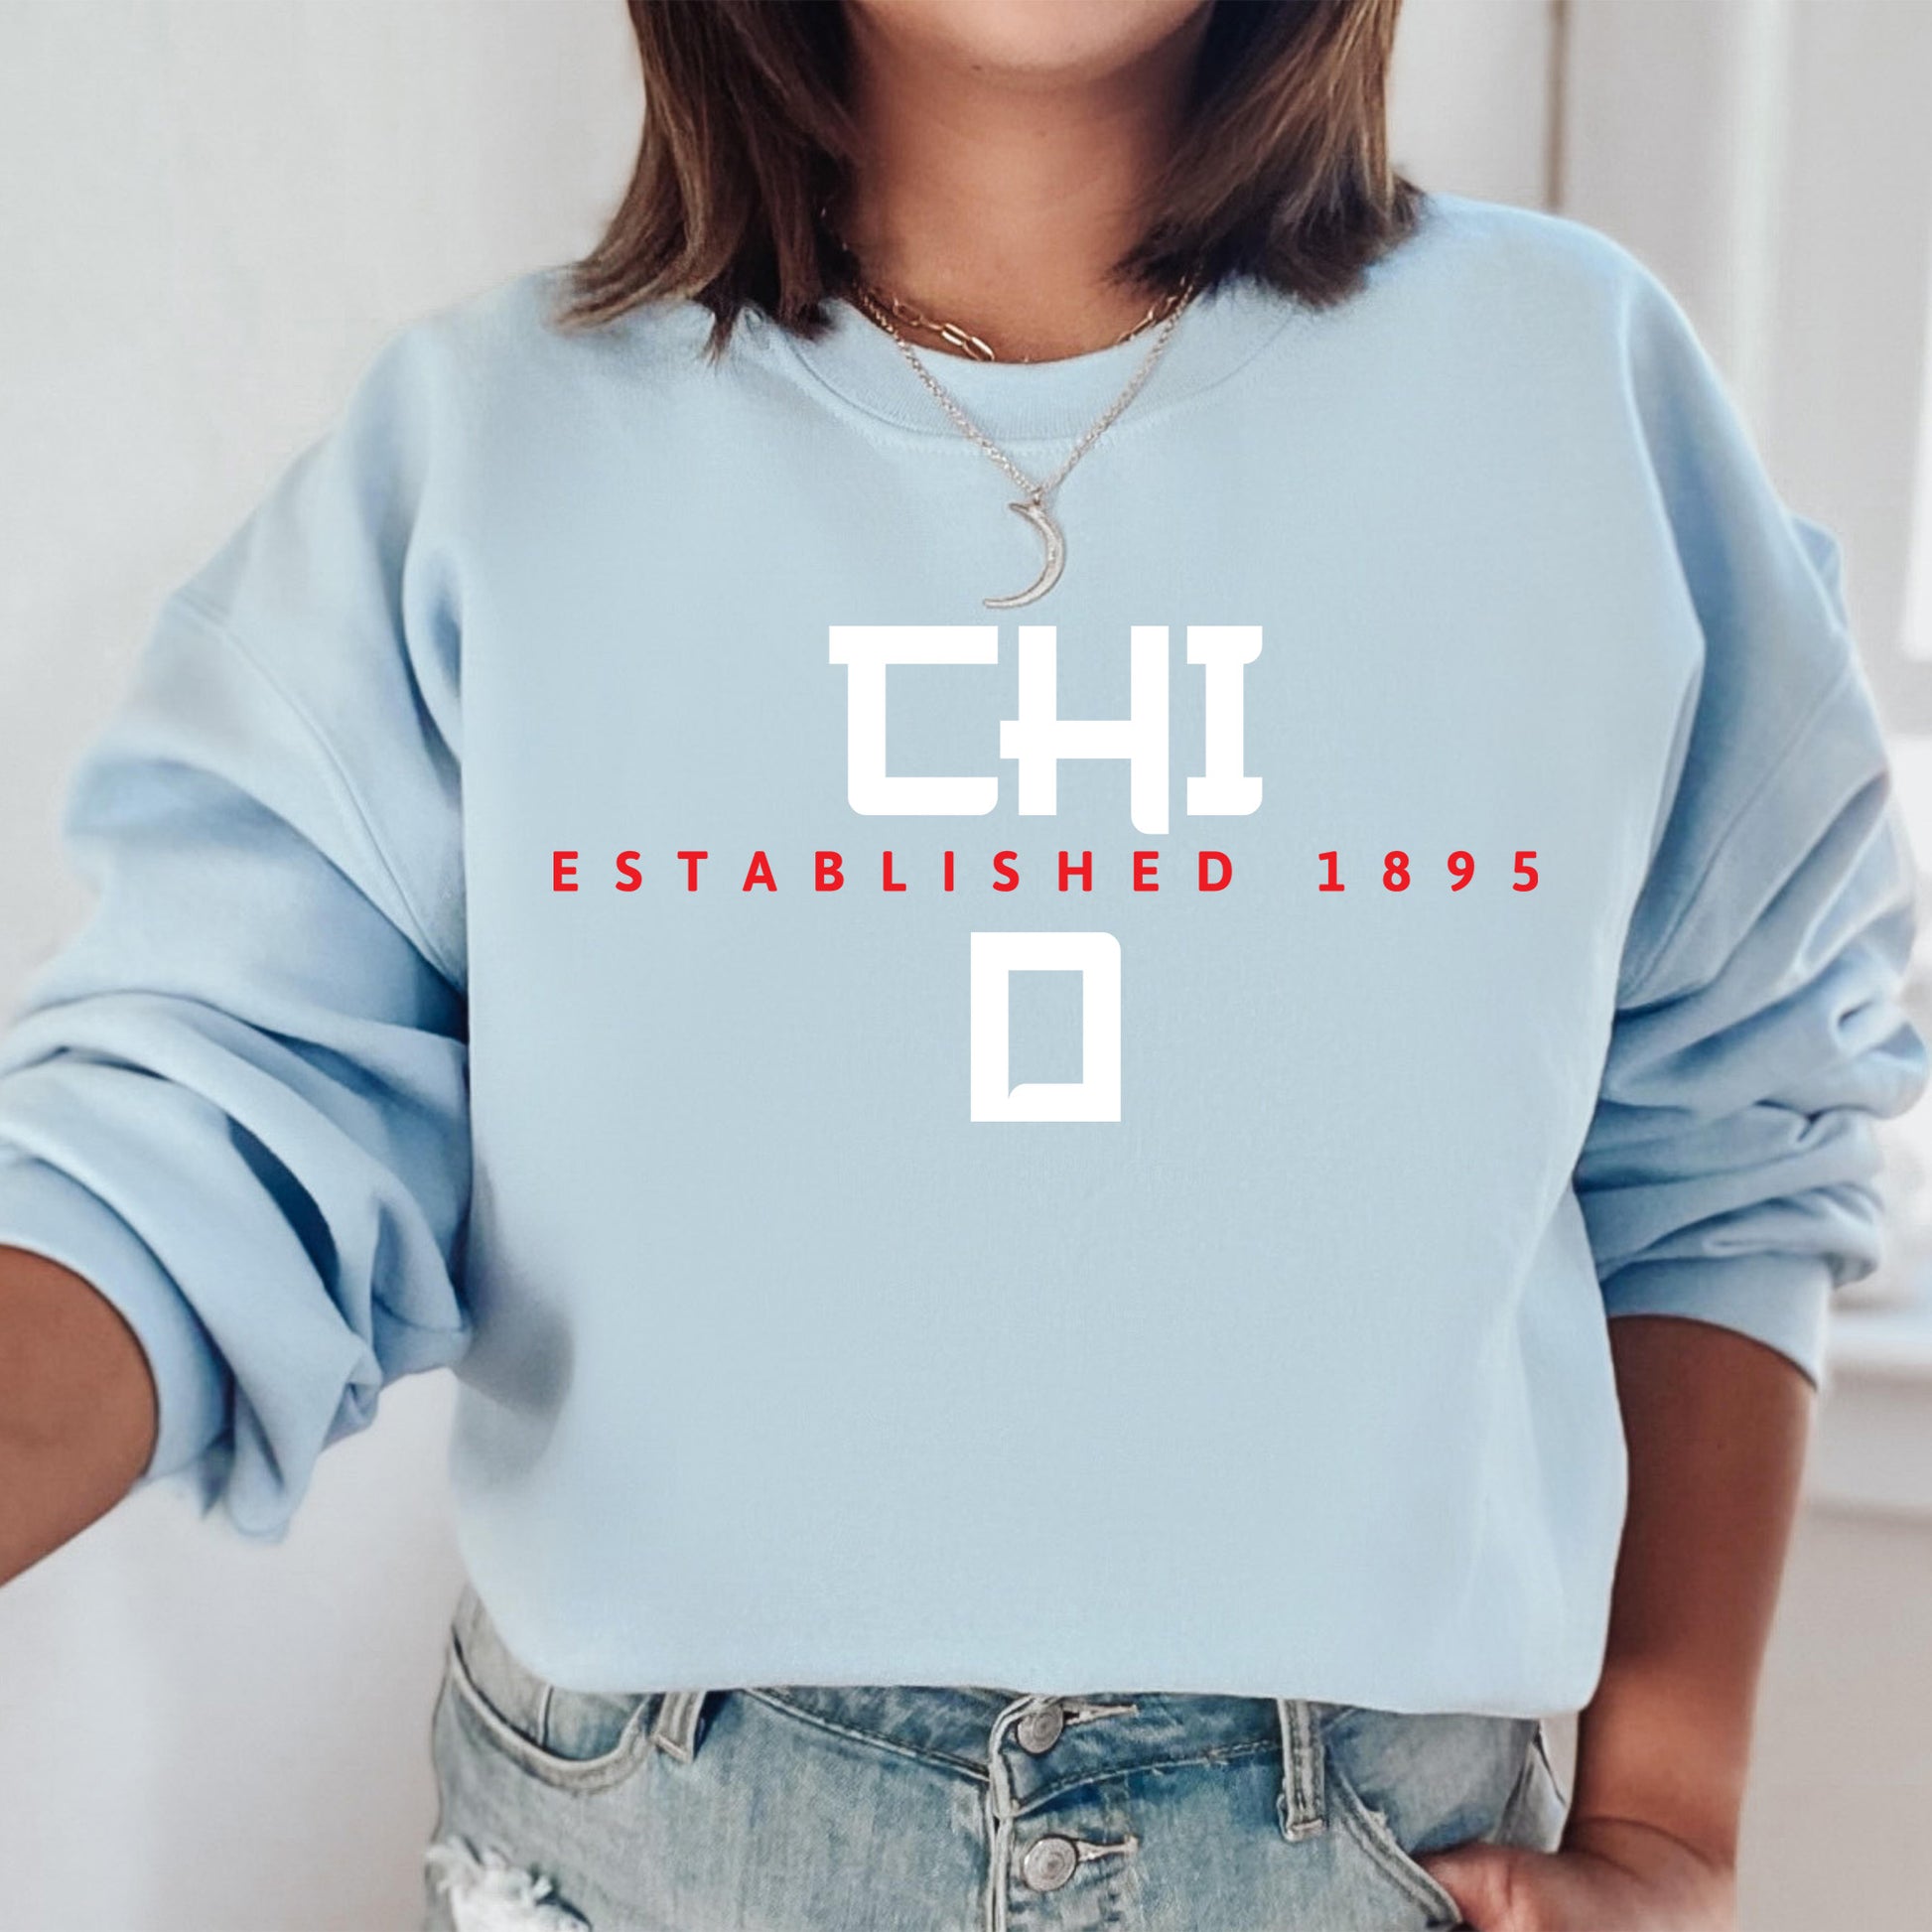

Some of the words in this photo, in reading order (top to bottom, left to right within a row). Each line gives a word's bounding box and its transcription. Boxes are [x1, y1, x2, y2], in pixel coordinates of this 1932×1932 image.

[829, 625, 1263, 835] CHI
[553, 850, 1233, 893] ESTABLISHED
[1317, 850, 1540, 893] 1895
